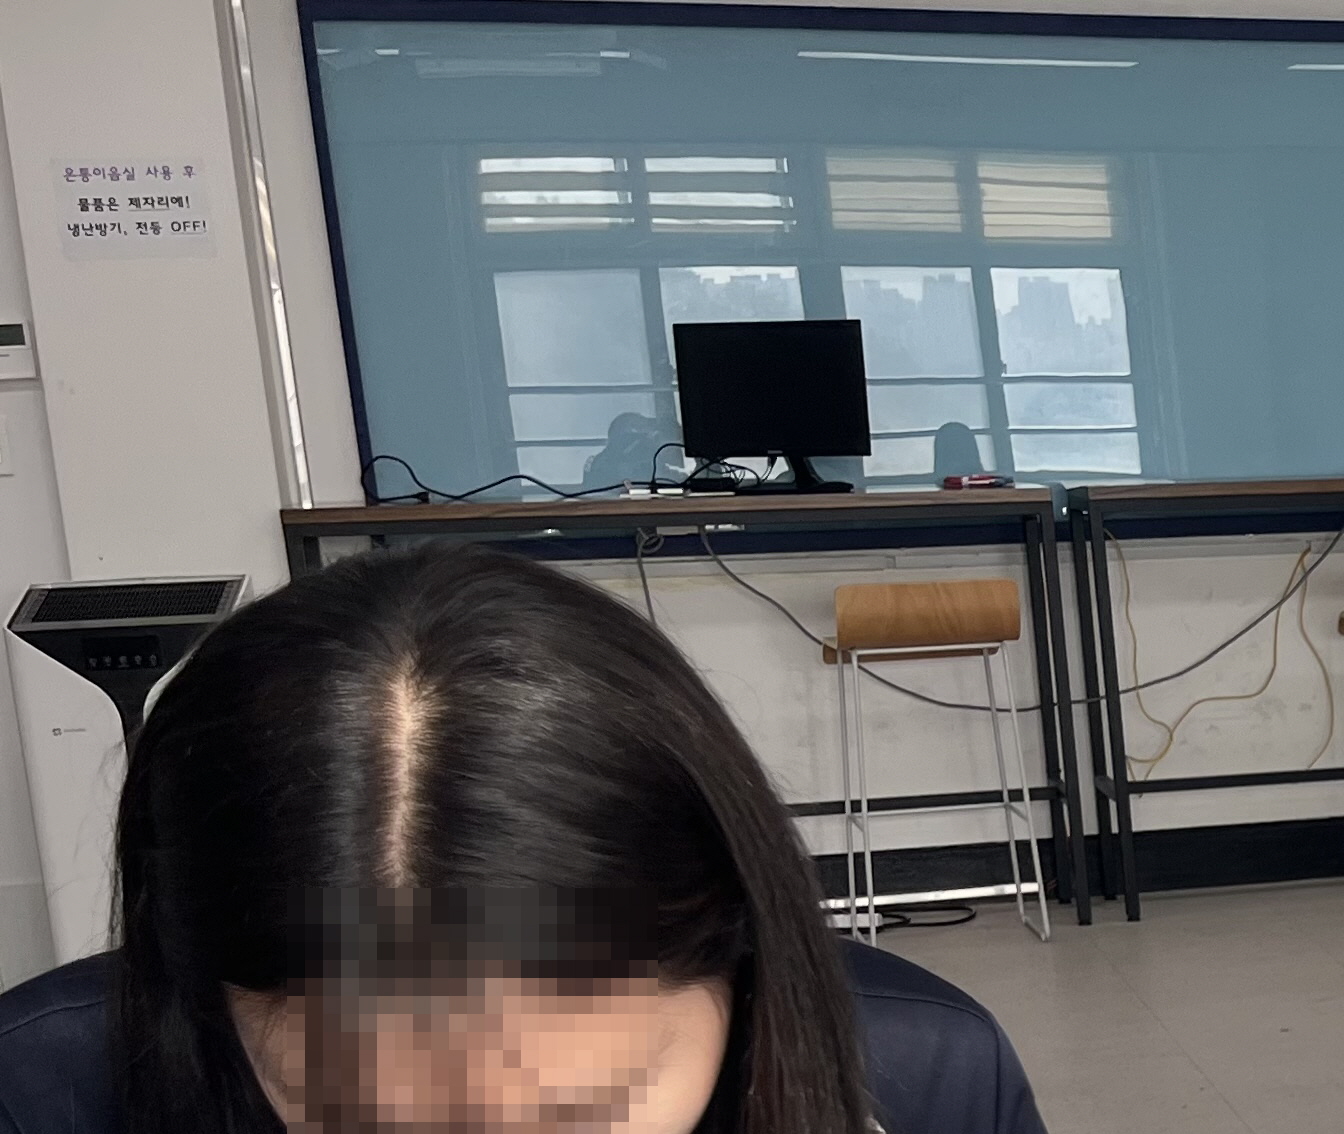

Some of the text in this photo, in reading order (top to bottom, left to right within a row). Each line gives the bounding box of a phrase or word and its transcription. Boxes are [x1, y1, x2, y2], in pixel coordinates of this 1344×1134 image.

[145, 165, 173, 181] 사용
[182, 165, 196, 179] 후
[77, 195, 191, 212] 물품은 제자리에!
[135, 221, 162, 236] 전등
[170, 220, 207, 234] OFF!
